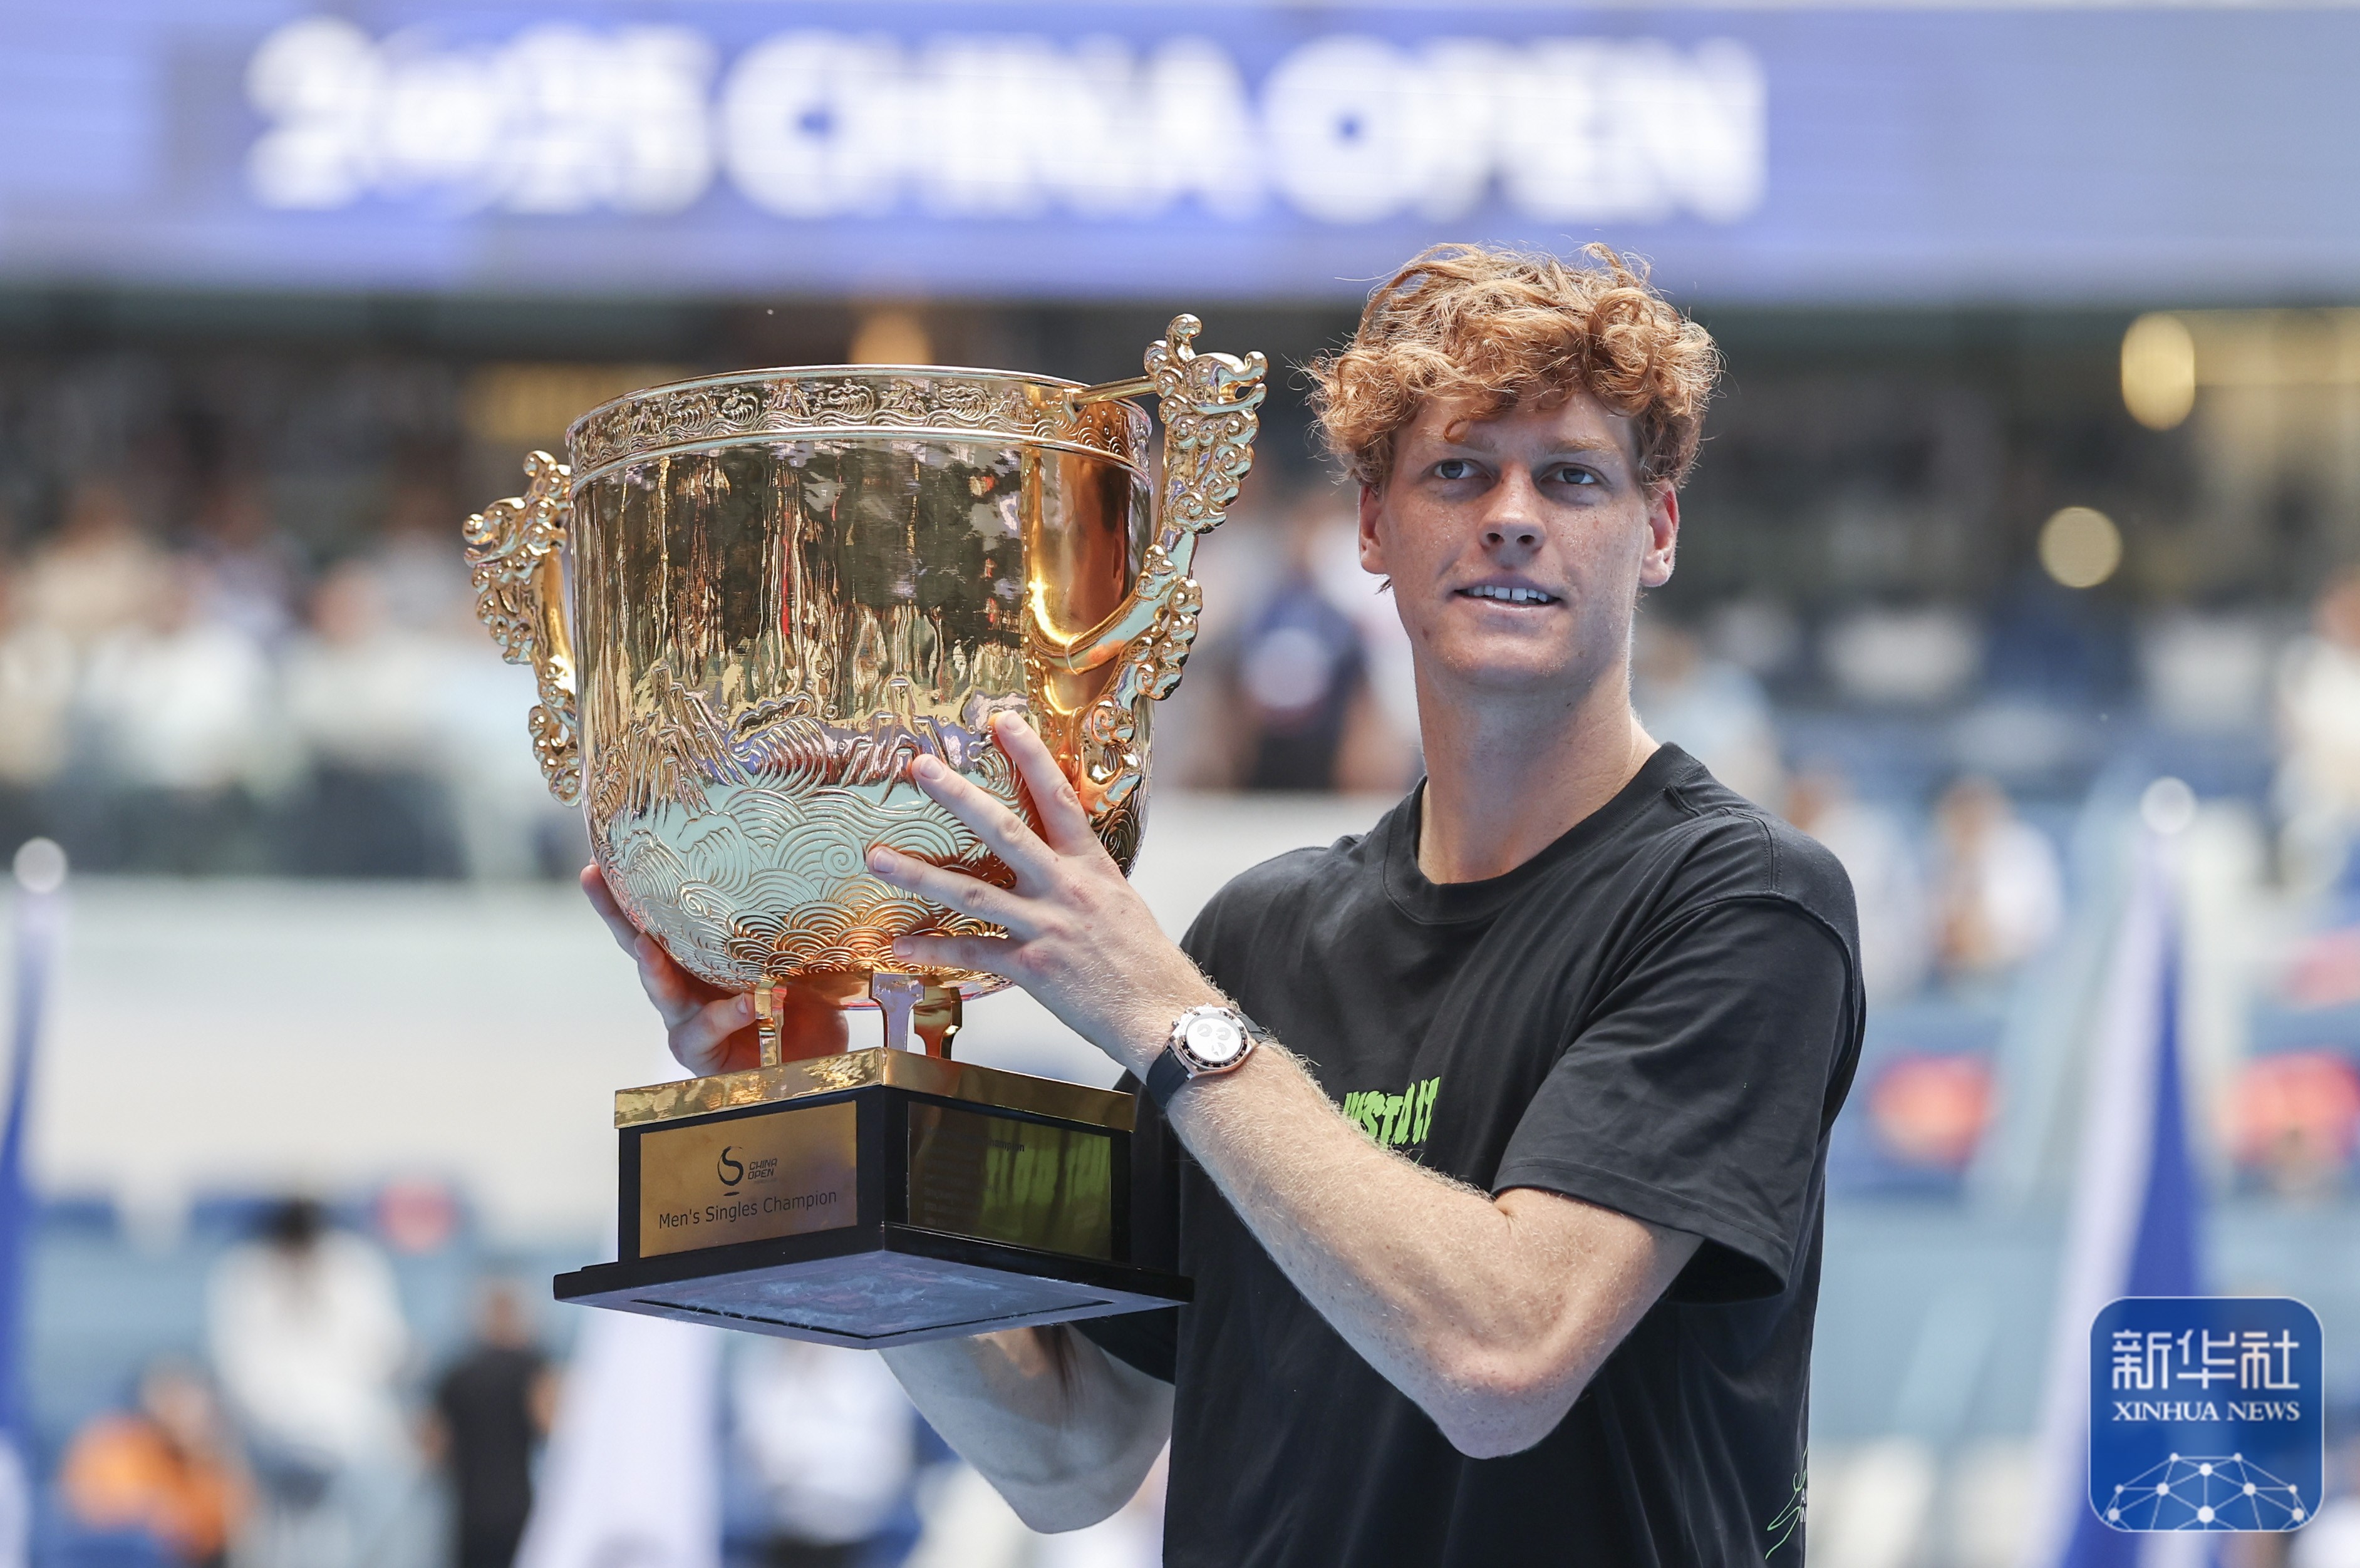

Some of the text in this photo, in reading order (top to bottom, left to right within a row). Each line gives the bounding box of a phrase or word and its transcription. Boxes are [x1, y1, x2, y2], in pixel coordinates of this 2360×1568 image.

[722, 30, 1259, 222] CHINA
[1260, 34, 1766, 224] OPEN
[748, 1168, 774, 1180] OPEN
[749, 1158, 777, 1170] CHINA
[659, 1190, 837, 1229] Men's Singles Champion
